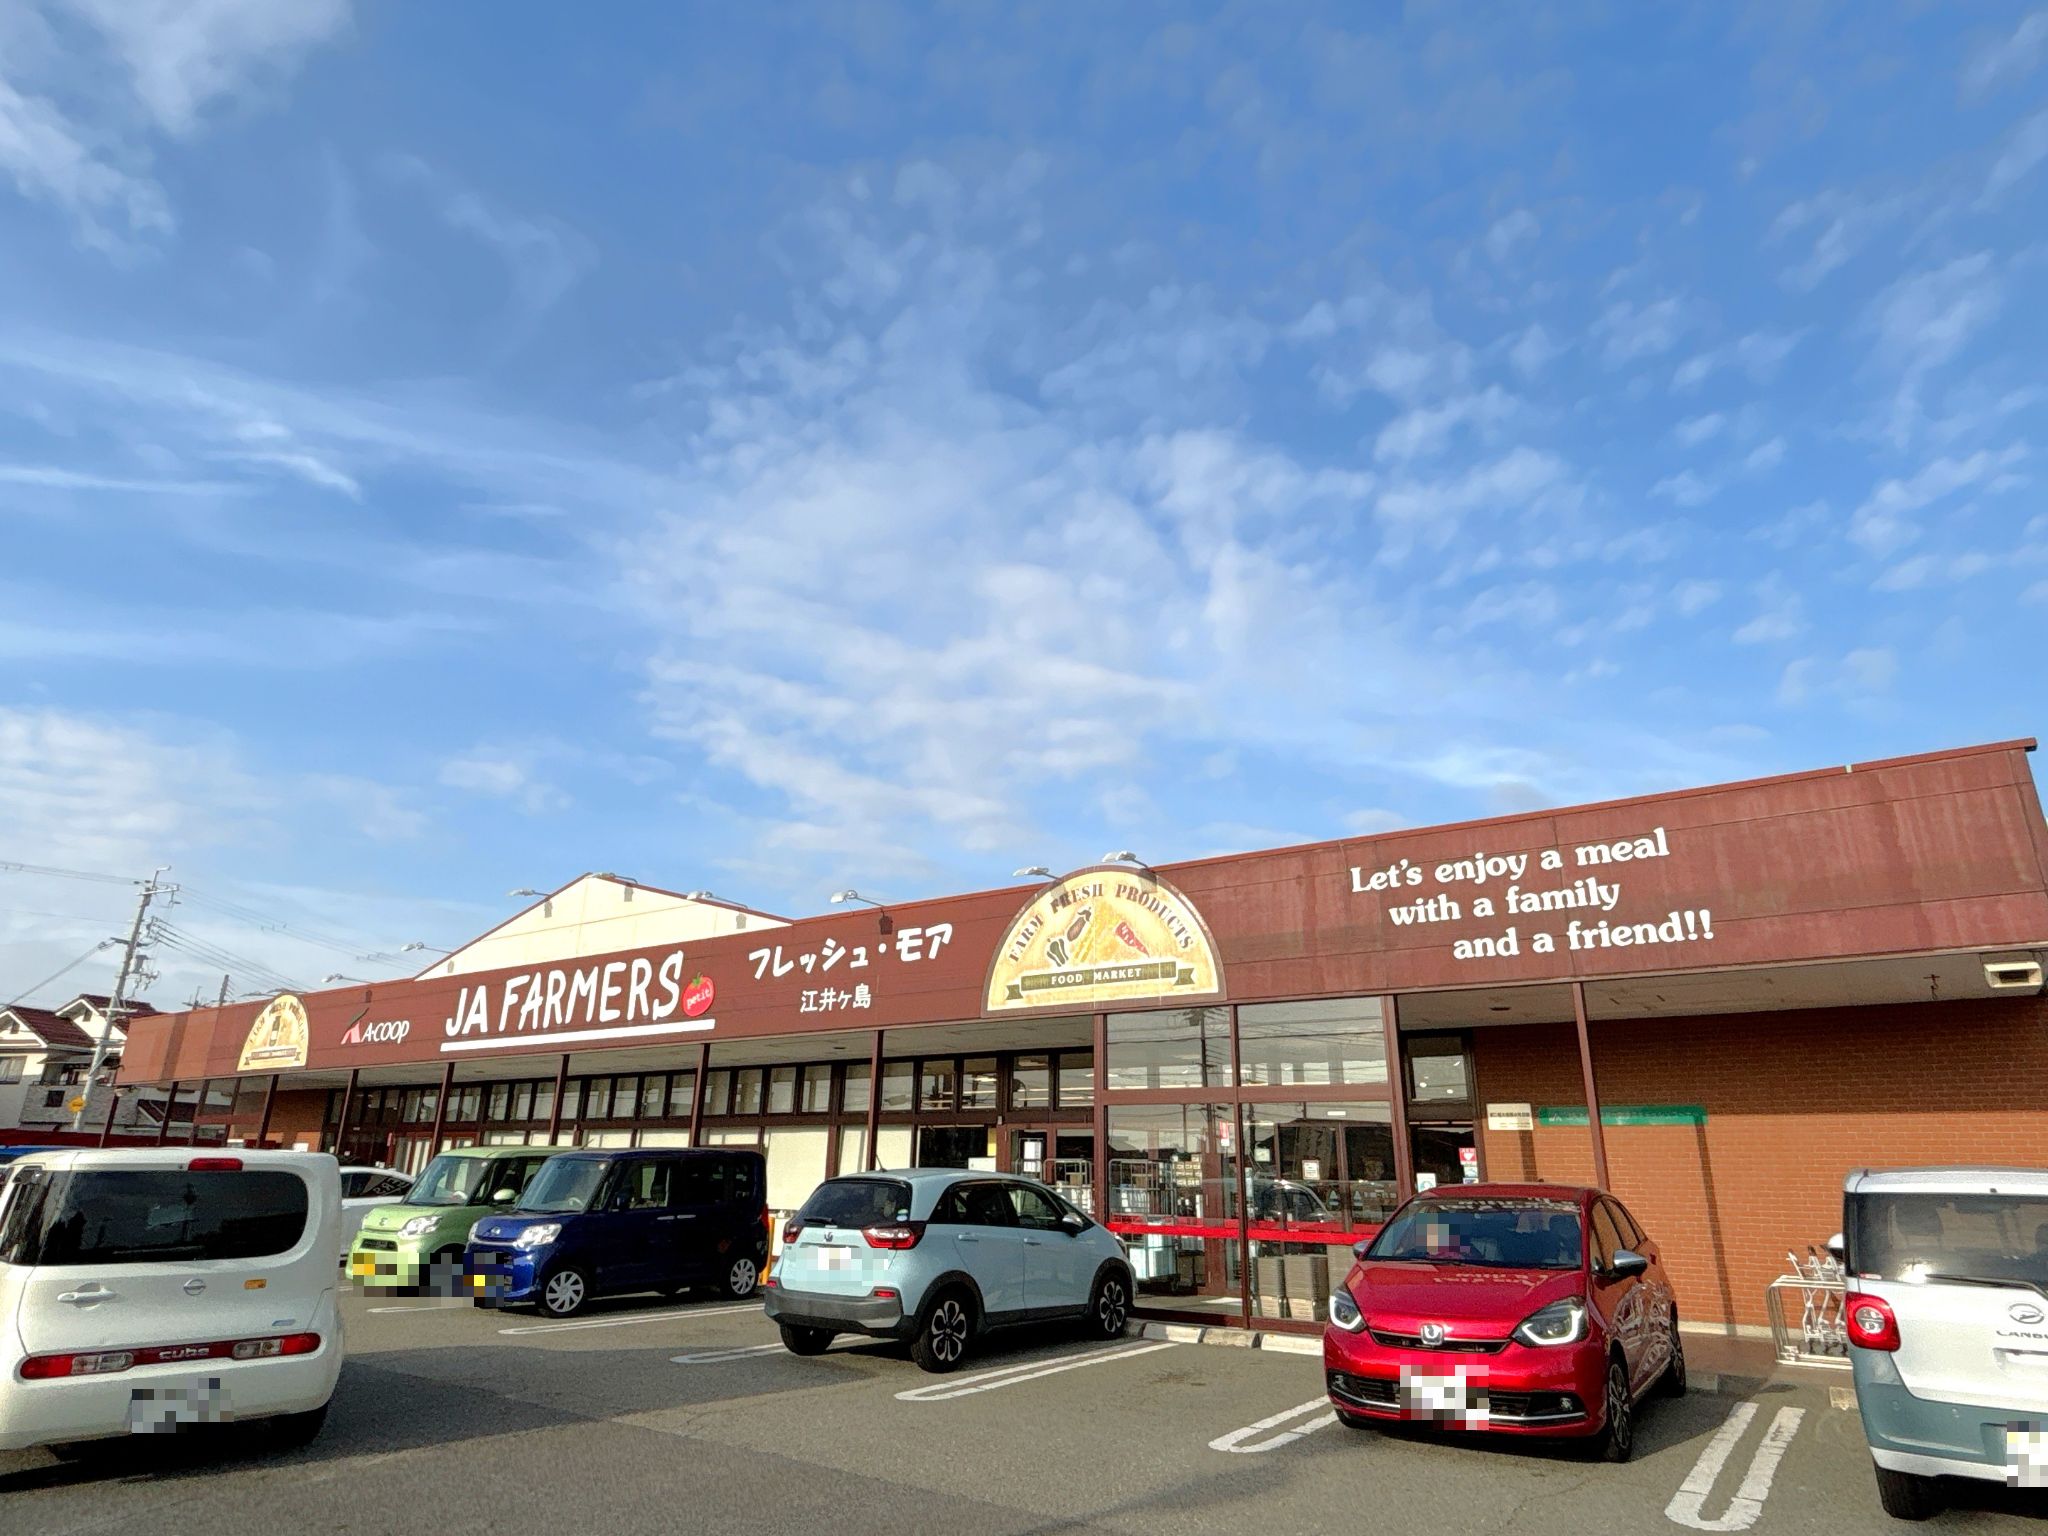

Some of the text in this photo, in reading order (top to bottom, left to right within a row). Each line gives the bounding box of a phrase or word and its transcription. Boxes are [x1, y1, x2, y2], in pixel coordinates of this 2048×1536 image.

[1350, 827, 1670, 893] Let's enjoy a meal
[1008, 883, 1194, 963] FARM FRESH PRODUCTS
[1388, 876, 1621, 926] with a family
[1452, 909, 1714, 960] and a friend!!
[445, 950, 684, 1036] JA FARMERS
[686, 988, 710, 1010] petit
[1051, 968, 1142, 985] FOOD MARKET
